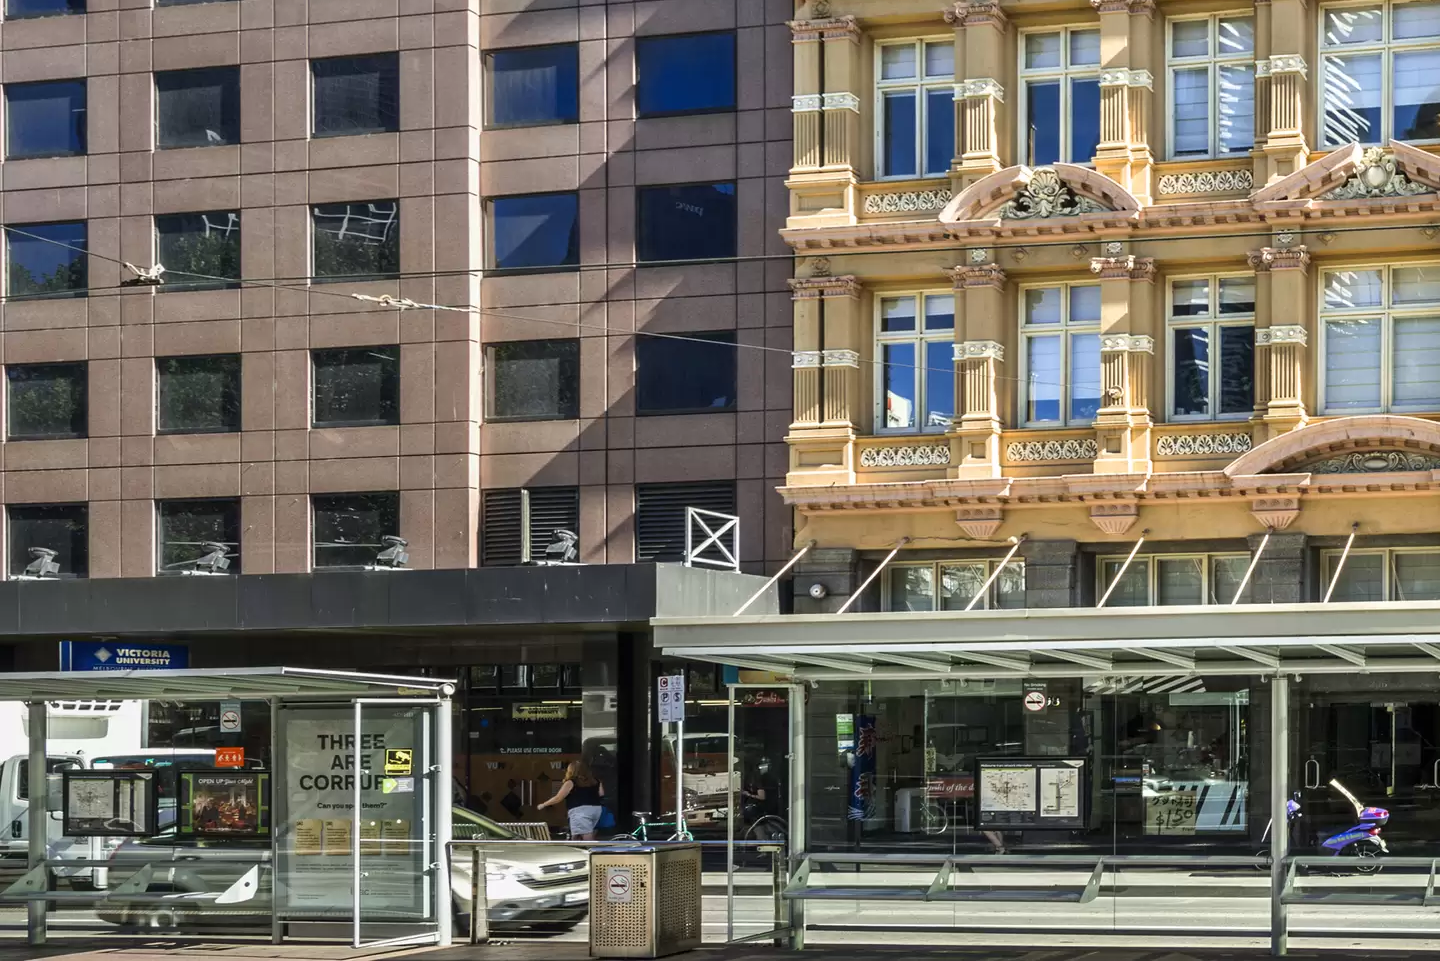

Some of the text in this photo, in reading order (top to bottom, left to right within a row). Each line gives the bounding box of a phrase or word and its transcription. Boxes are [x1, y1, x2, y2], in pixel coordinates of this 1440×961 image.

[116, 649, 170, 658] VICTORIA
[116, 657, 170, 665] UNIVERSITY
[317, 734, 386, 750] THREE
[331, 755, 372, 770] ARE
[300, 775, 386, 790] CORRUP
[946, 784, 954, 793] of
[955, 783, 967, 791] the
